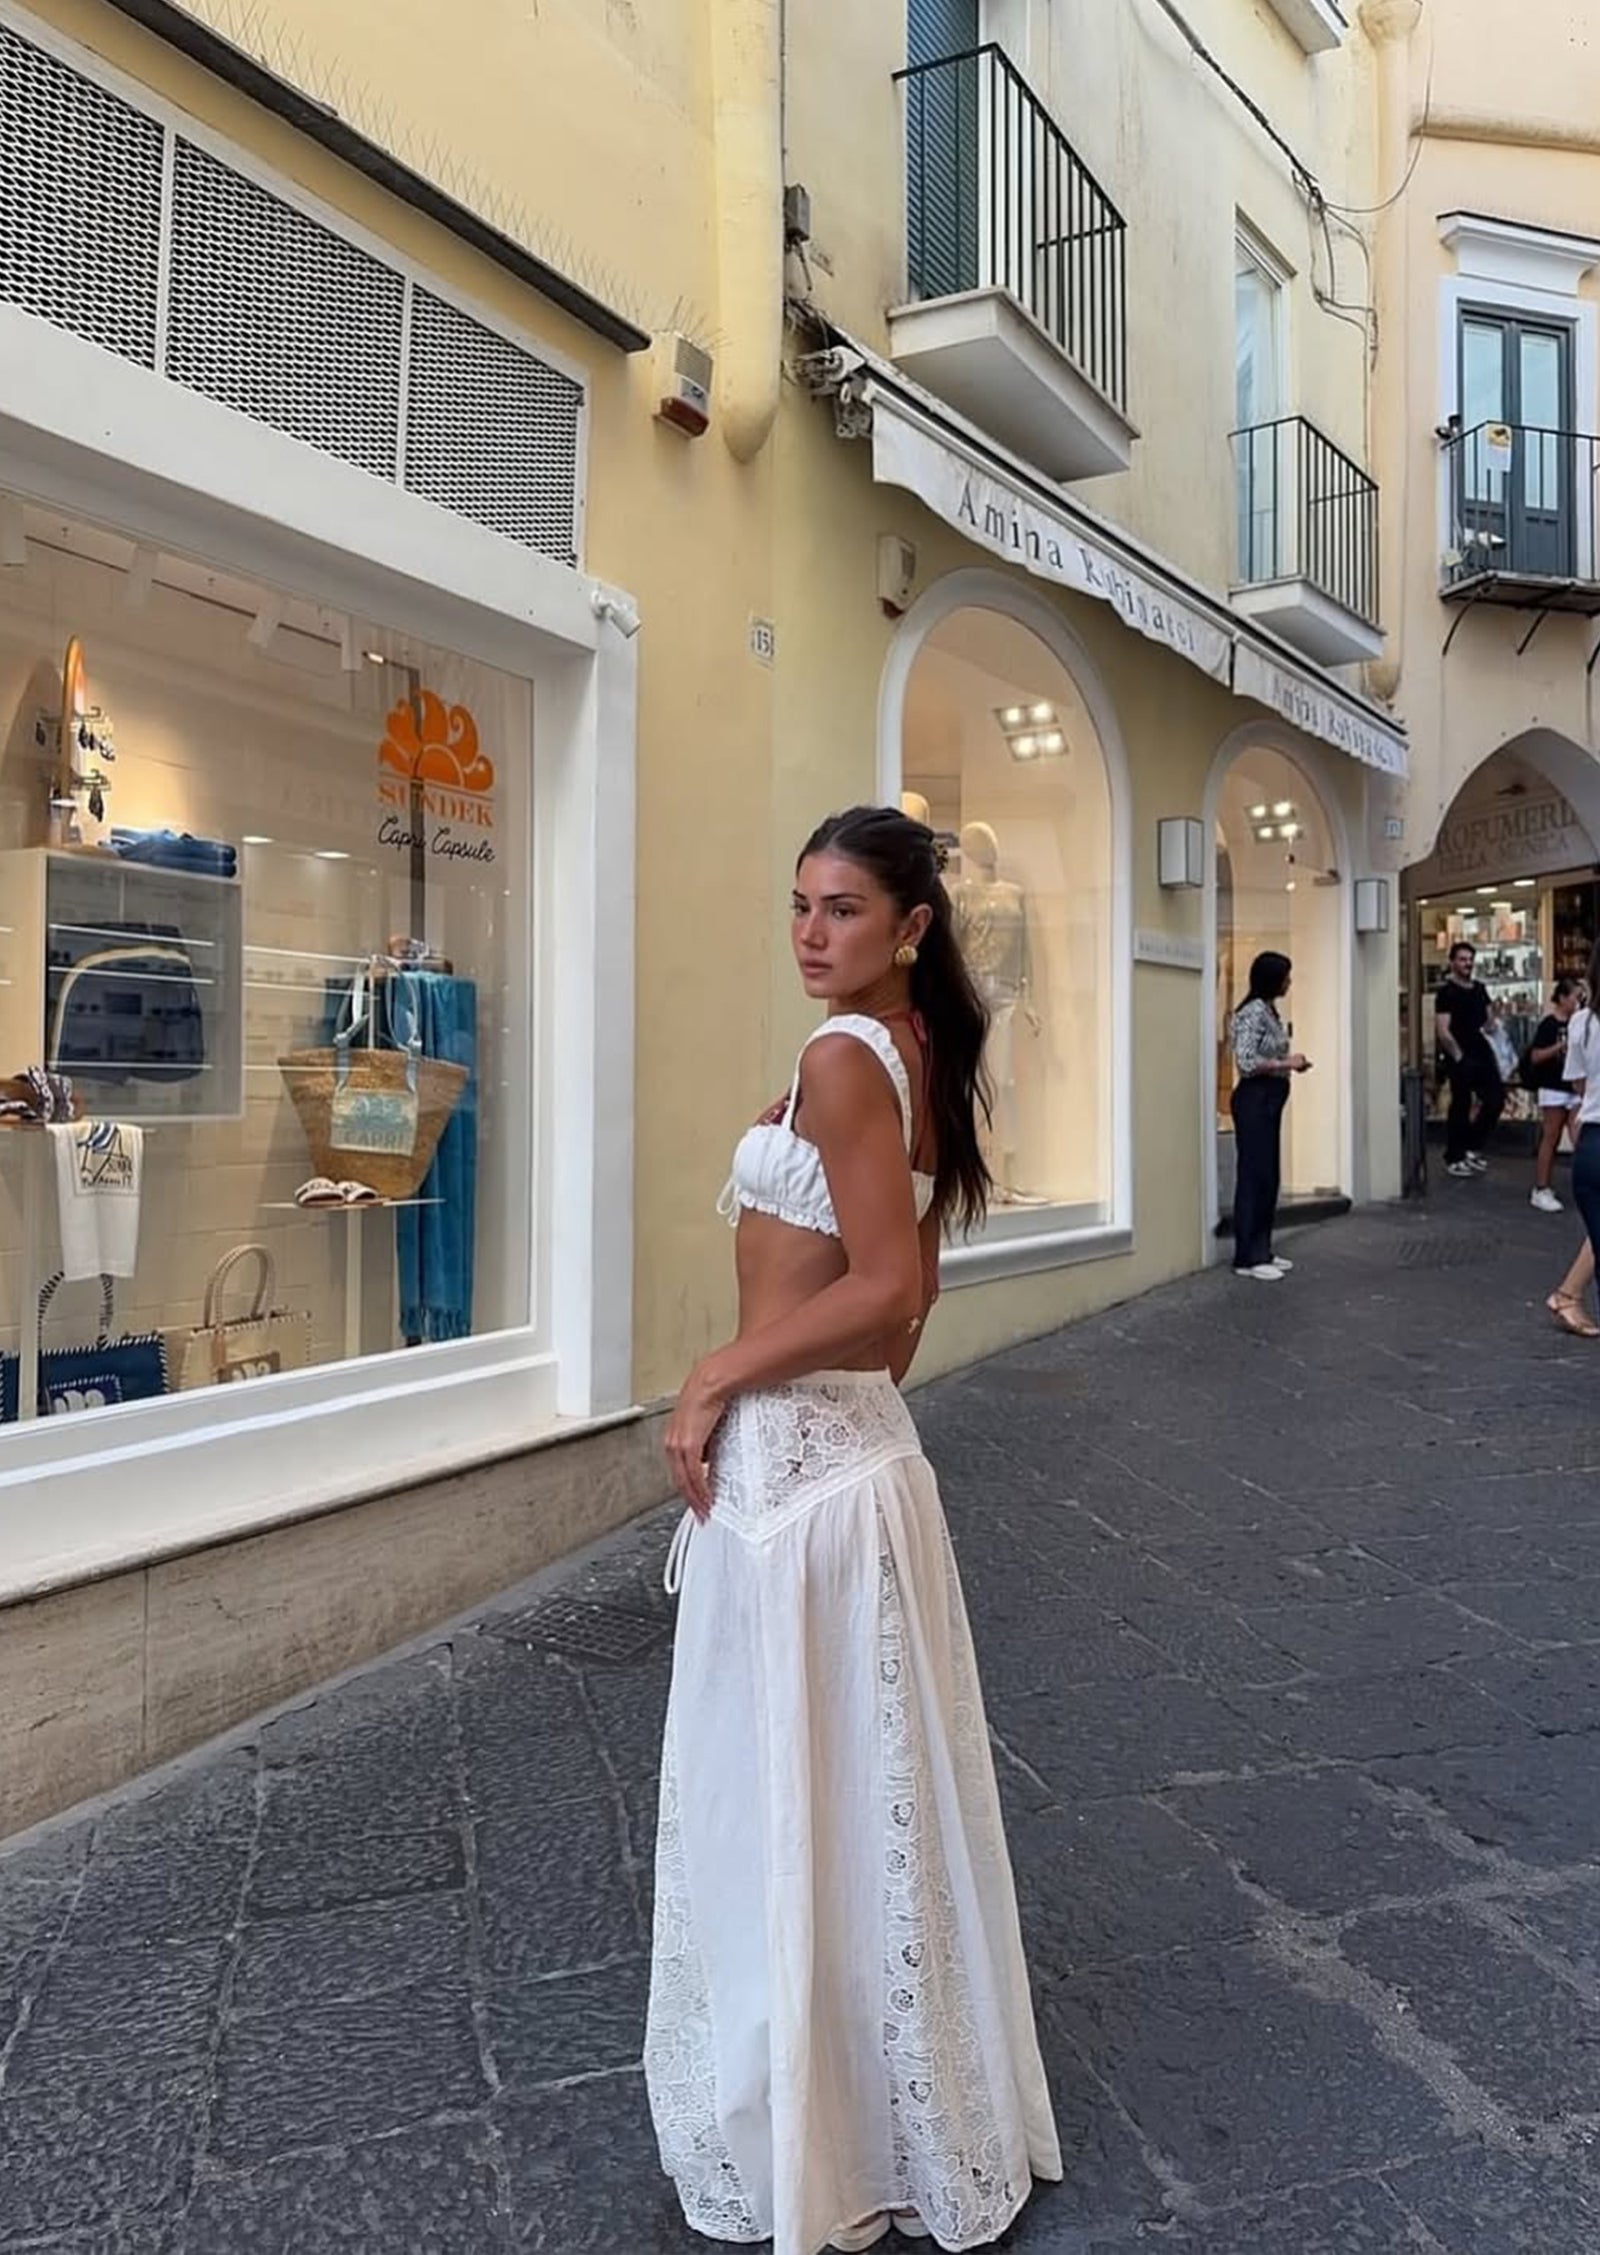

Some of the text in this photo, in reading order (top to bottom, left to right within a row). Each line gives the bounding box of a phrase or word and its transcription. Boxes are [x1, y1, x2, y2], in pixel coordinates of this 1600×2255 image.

[958, 481, 1064, 569] Amina
[377, 815, 496, 863] Capri Capsule
